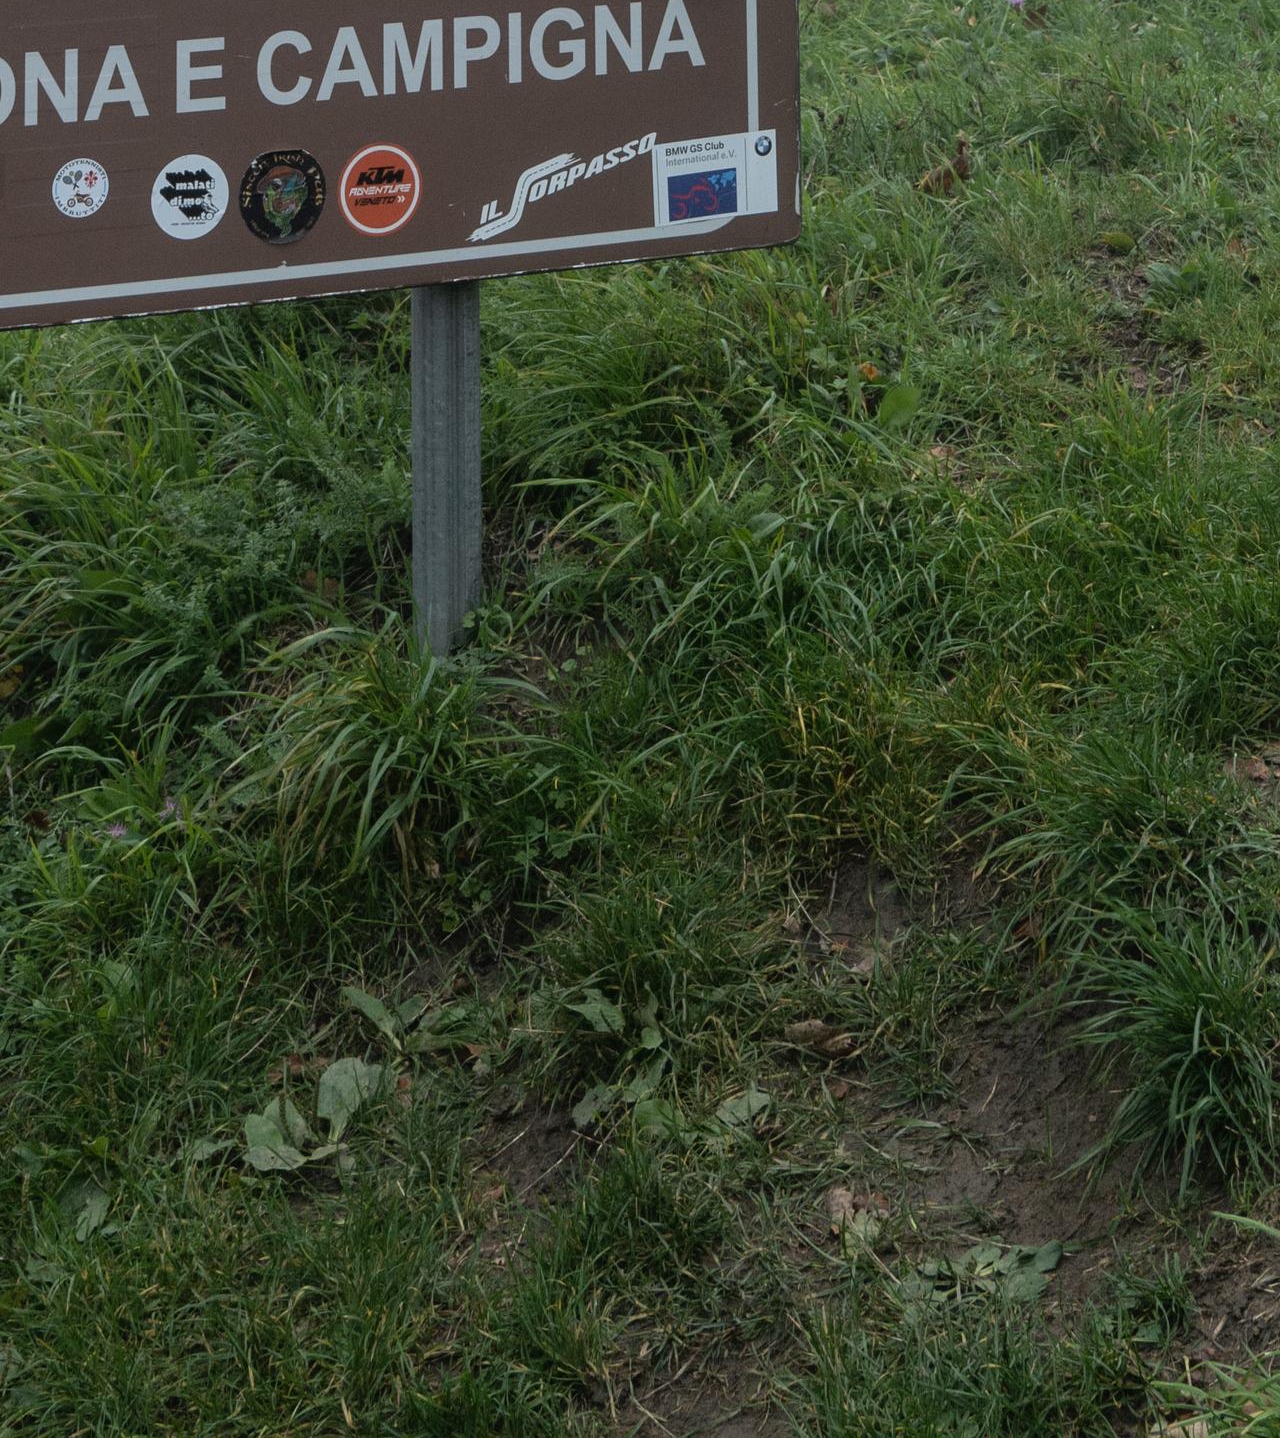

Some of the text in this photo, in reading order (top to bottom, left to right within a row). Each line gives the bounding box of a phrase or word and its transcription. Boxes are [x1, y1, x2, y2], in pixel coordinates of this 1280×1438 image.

[175, 37, 226, 114] E
[665, 140, 725, 158] BMW GS Club
[355, 166, 405, 185] KTM
[175, 179, 217, 192] malati
[349, 183, 412, 198] ADVENTURE
